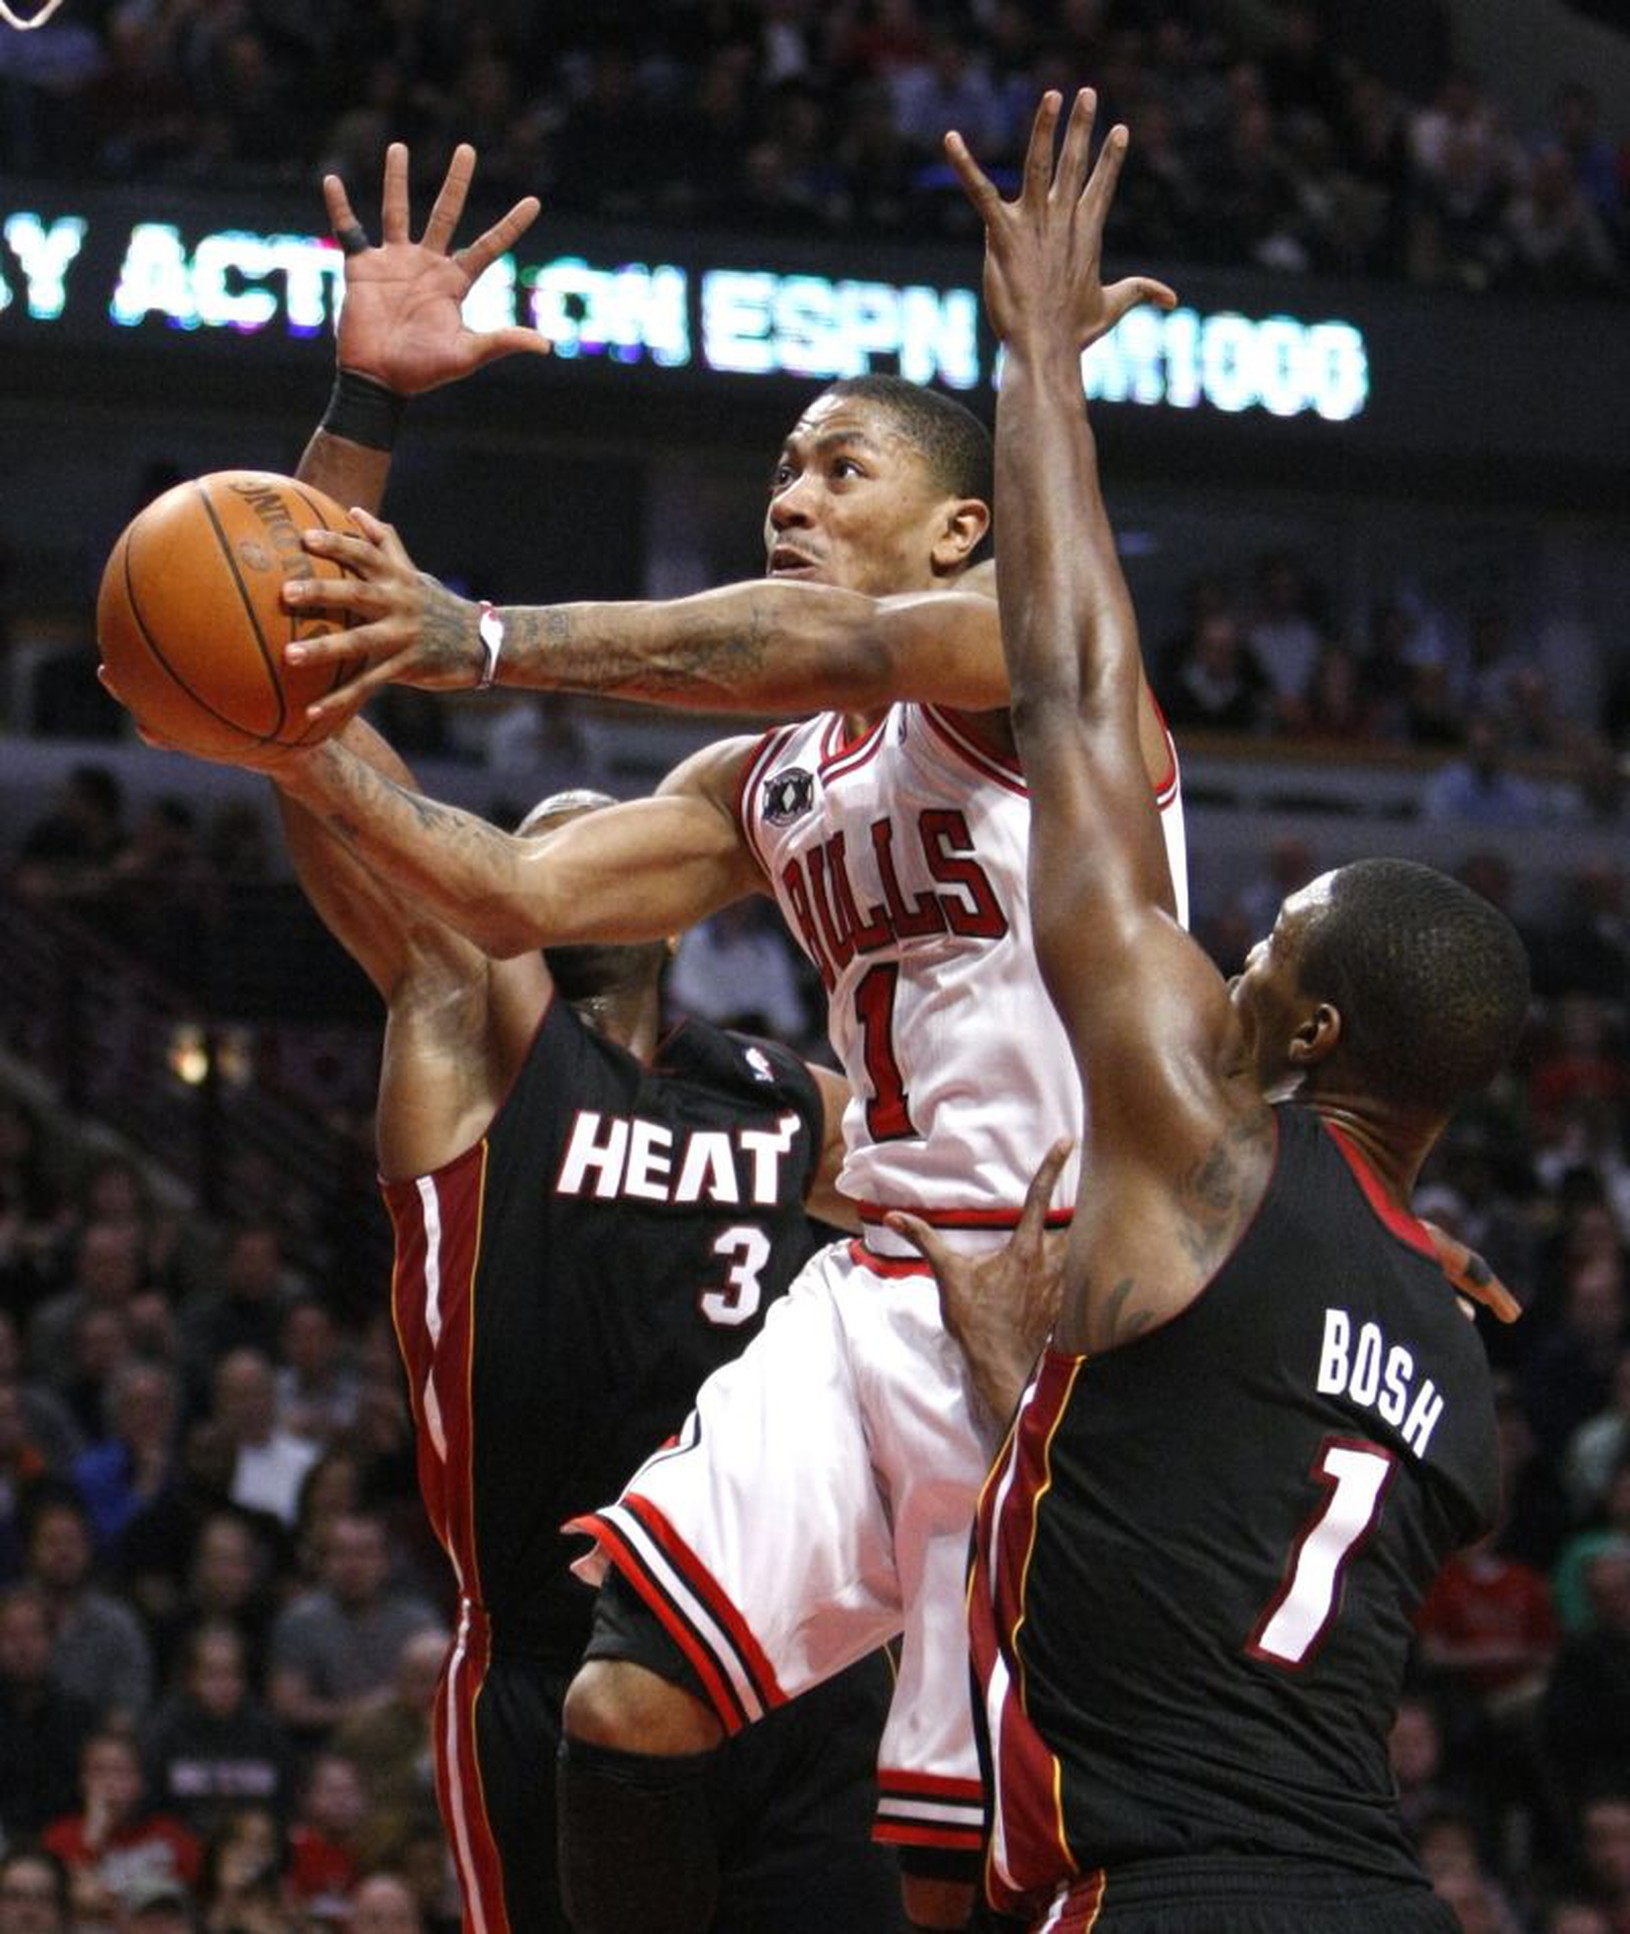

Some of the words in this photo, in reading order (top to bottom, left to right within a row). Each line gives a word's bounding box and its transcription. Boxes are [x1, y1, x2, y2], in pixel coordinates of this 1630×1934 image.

[0, 211, 88, 319] Y
[108, 221, 517, 338] ACT
[529, 257, 691, 366] ON
[702, 269, 979, 389] ESPN
[992, 304, 1369, 421] M1000
[781, 808, 1009, 996] BULLS
[853, 961, 922, 1143] 1
[555, 1108, 802, 1205] HEAT
[699, 1224, 772, 1328] 3
[1316, 1307, 1445, 1460] BOSH
[1247, 1438, 1397, 1669] 1
